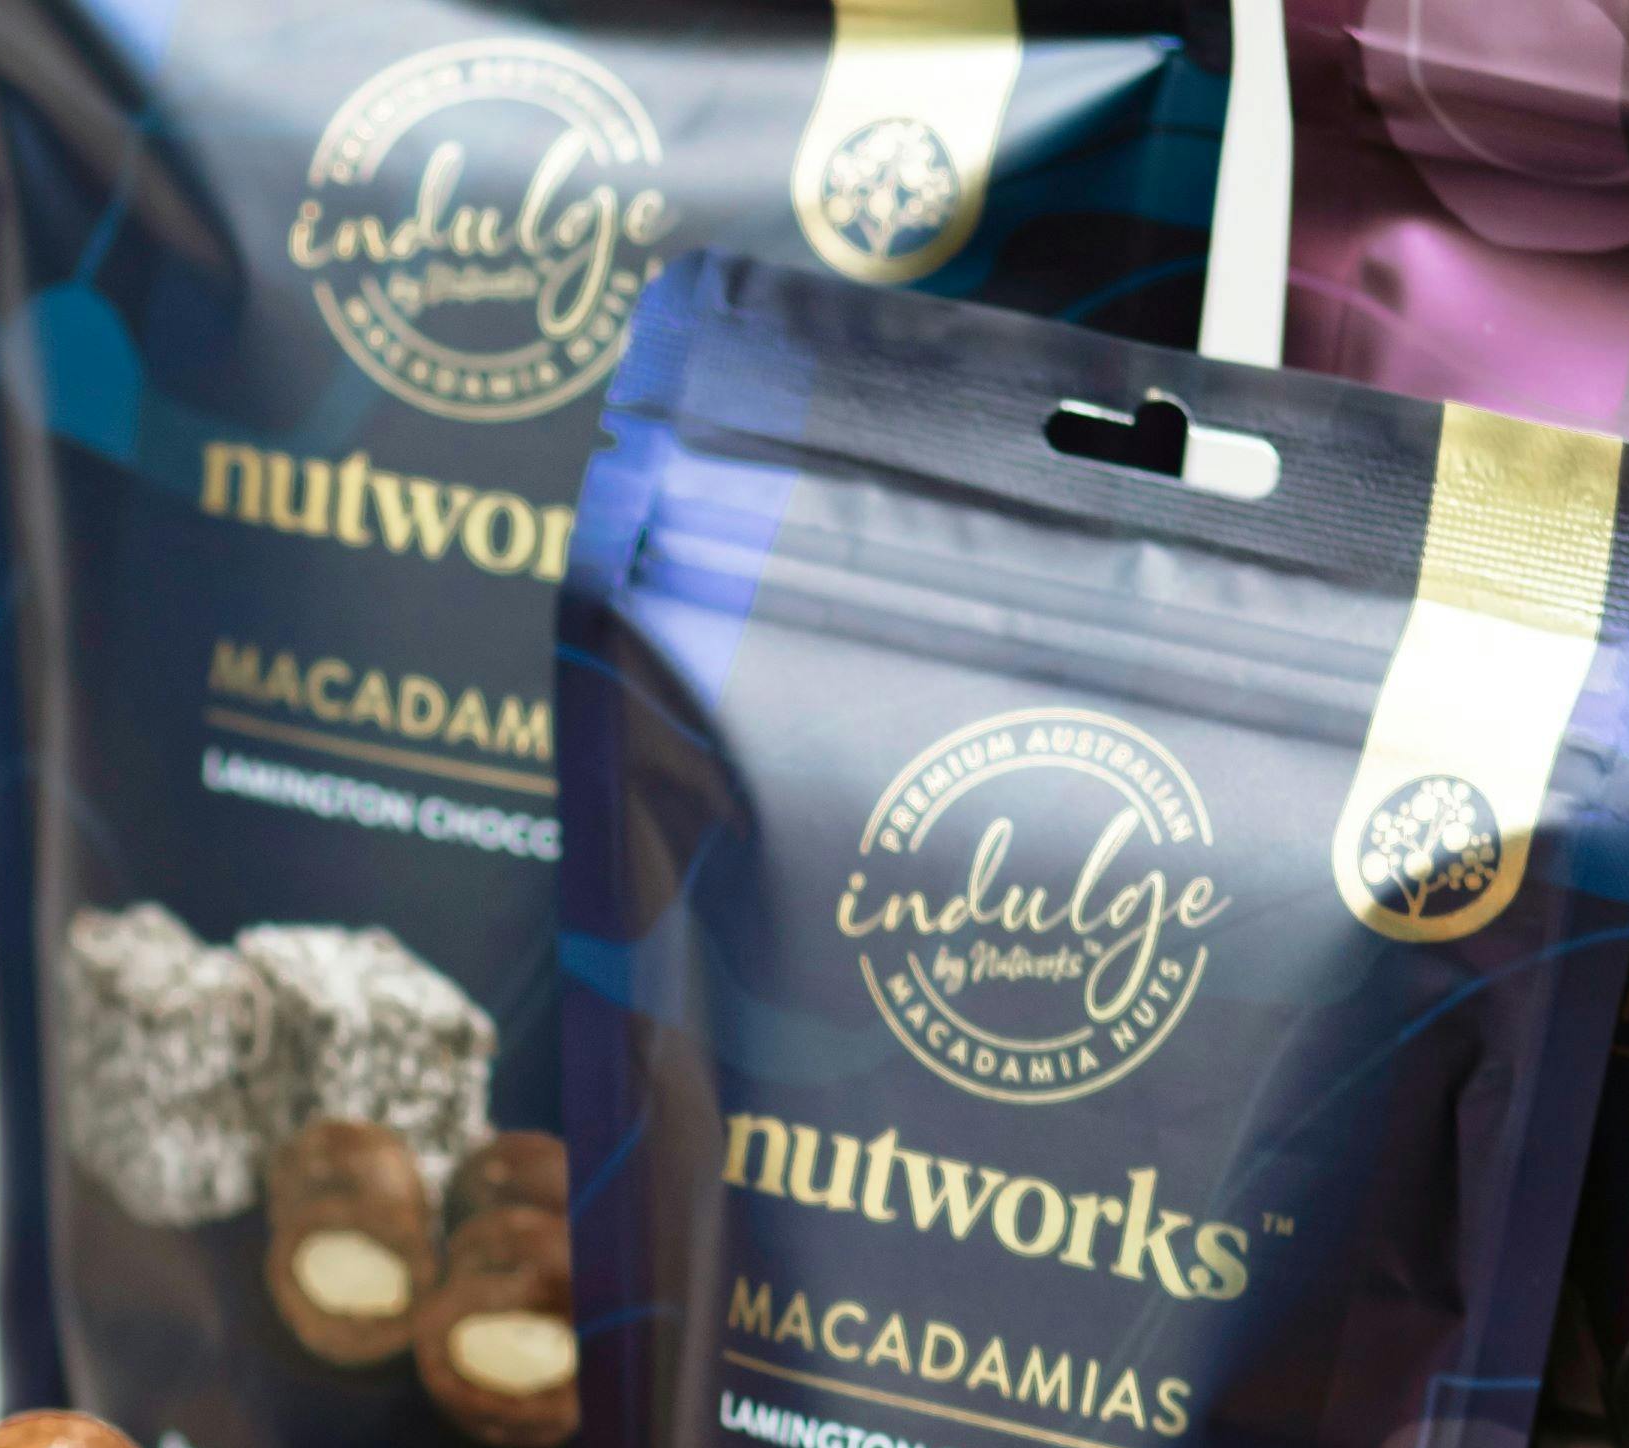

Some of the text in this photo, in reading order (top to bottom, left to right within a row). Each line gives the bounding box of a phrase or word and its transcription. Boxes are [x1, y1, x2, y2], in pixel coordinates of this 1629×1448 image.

[879, 726, 1195, 853] PREMIUM AUSTRALIAN
[836, 806, 1233, 1023] indulge
[885, 957, 1184, 1083] MACADAMIA NUTS
[721, 1111, 1250, 1302] nutworks
[727, 1276, 1192, 1439] MACADAMIAS
